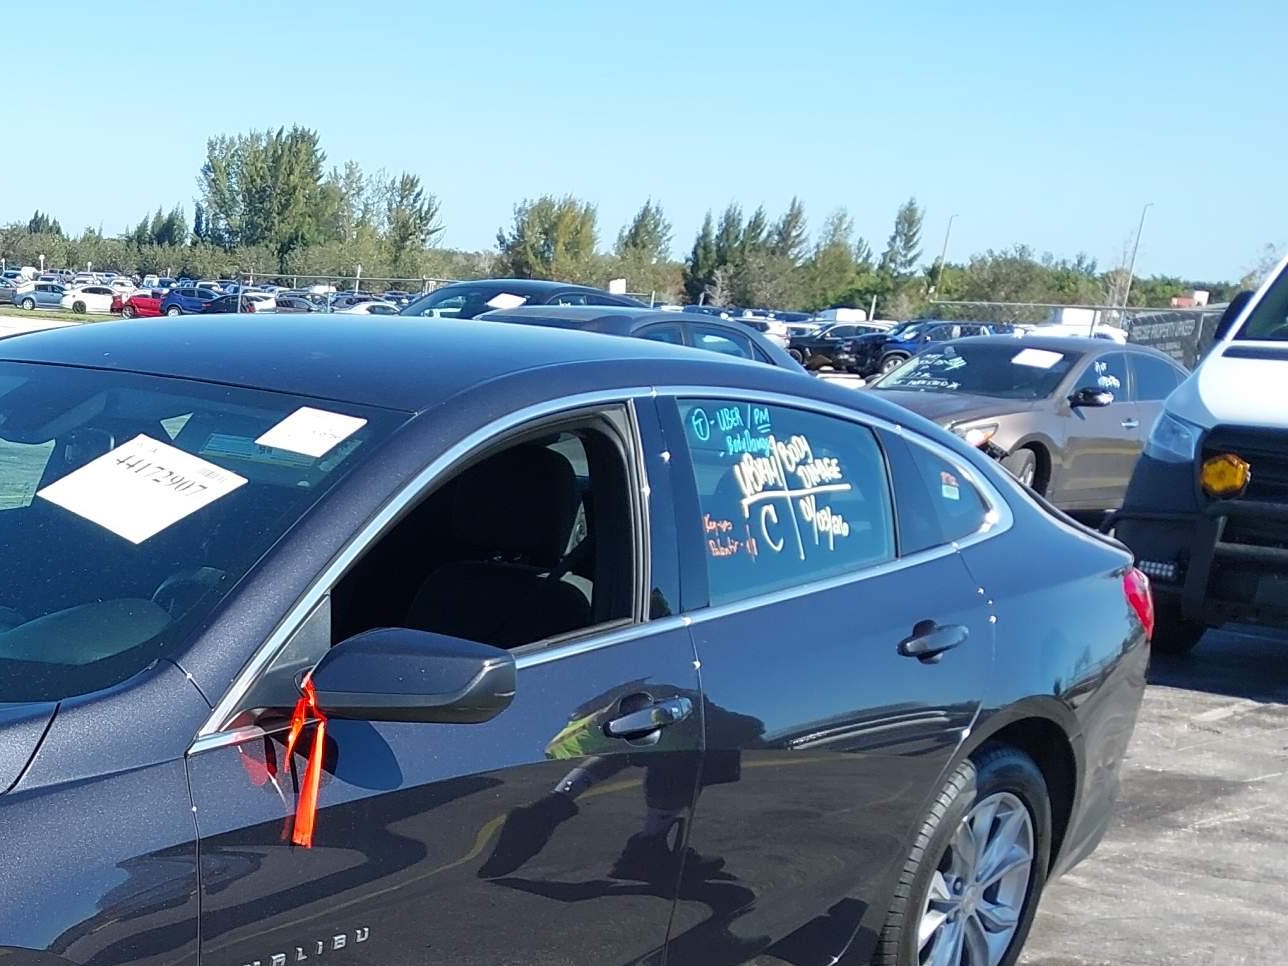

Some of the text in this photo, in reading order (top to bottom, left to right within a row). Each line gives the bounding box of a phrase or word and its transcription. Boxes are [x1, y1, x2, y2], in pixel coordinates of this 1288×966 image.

[716, 406, 745, 431] UBER
[753, 408, 771, 425] PM
[115, 453, 209, 496] 44172907
[761, 504, 784, 552] C
